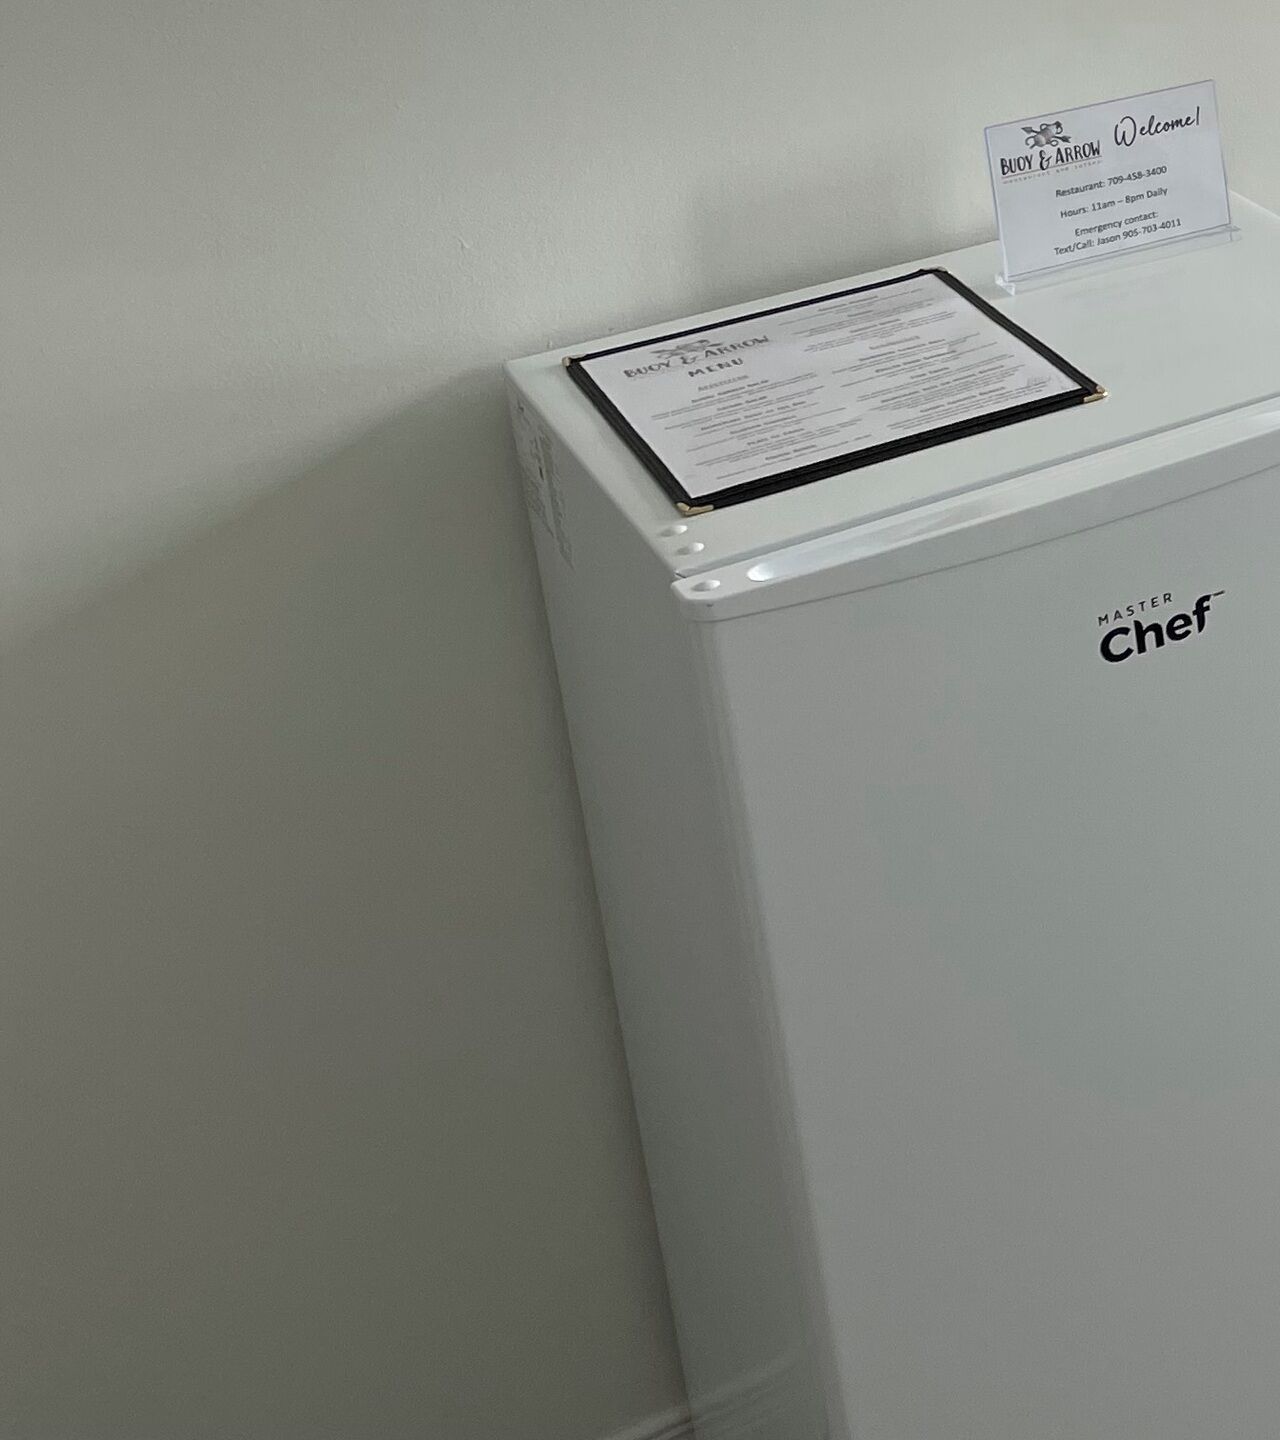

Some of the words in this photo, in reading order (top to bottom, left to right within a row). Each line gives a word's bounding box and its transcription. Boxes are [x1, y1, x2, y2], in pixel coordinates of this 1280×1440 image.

[1114, 106, 1200, 147] Welcome!
[1000, 154, 1034, 175] BUOY
[1039, 149, 1053, 171] &
[1055, 139, 1101, 164] ARROW
[1055, 181, 1105, 198] Restaurant:
[1107, 165, 1168, 187] 709-458-3400
[1060, 206, 1089, 219] Hours:
[1091, 200, 1115, 212] 11am
[1125, 193, 1145, 206] 8pm
[1146, 187, 1168, 199] Daily
[1054, 240, 1095, 255] Text/Call:
[1096, 234, 1121, 246] Jason
[1122, 218, 1182, 240] 905-703-4011
[1074, 220, 1122, 237] Emergency
[1124, 211, 1159, 226] contact:
[623, 359, 671, 378] BUOY
[680, 355, 698, 365] &
[704, 335, 770, 358] ARROW
[688, 357, 745, 378] MENU
[1097, 591, 1174, 627] MASTER
[1099, 594, 1212, 664] Chef
